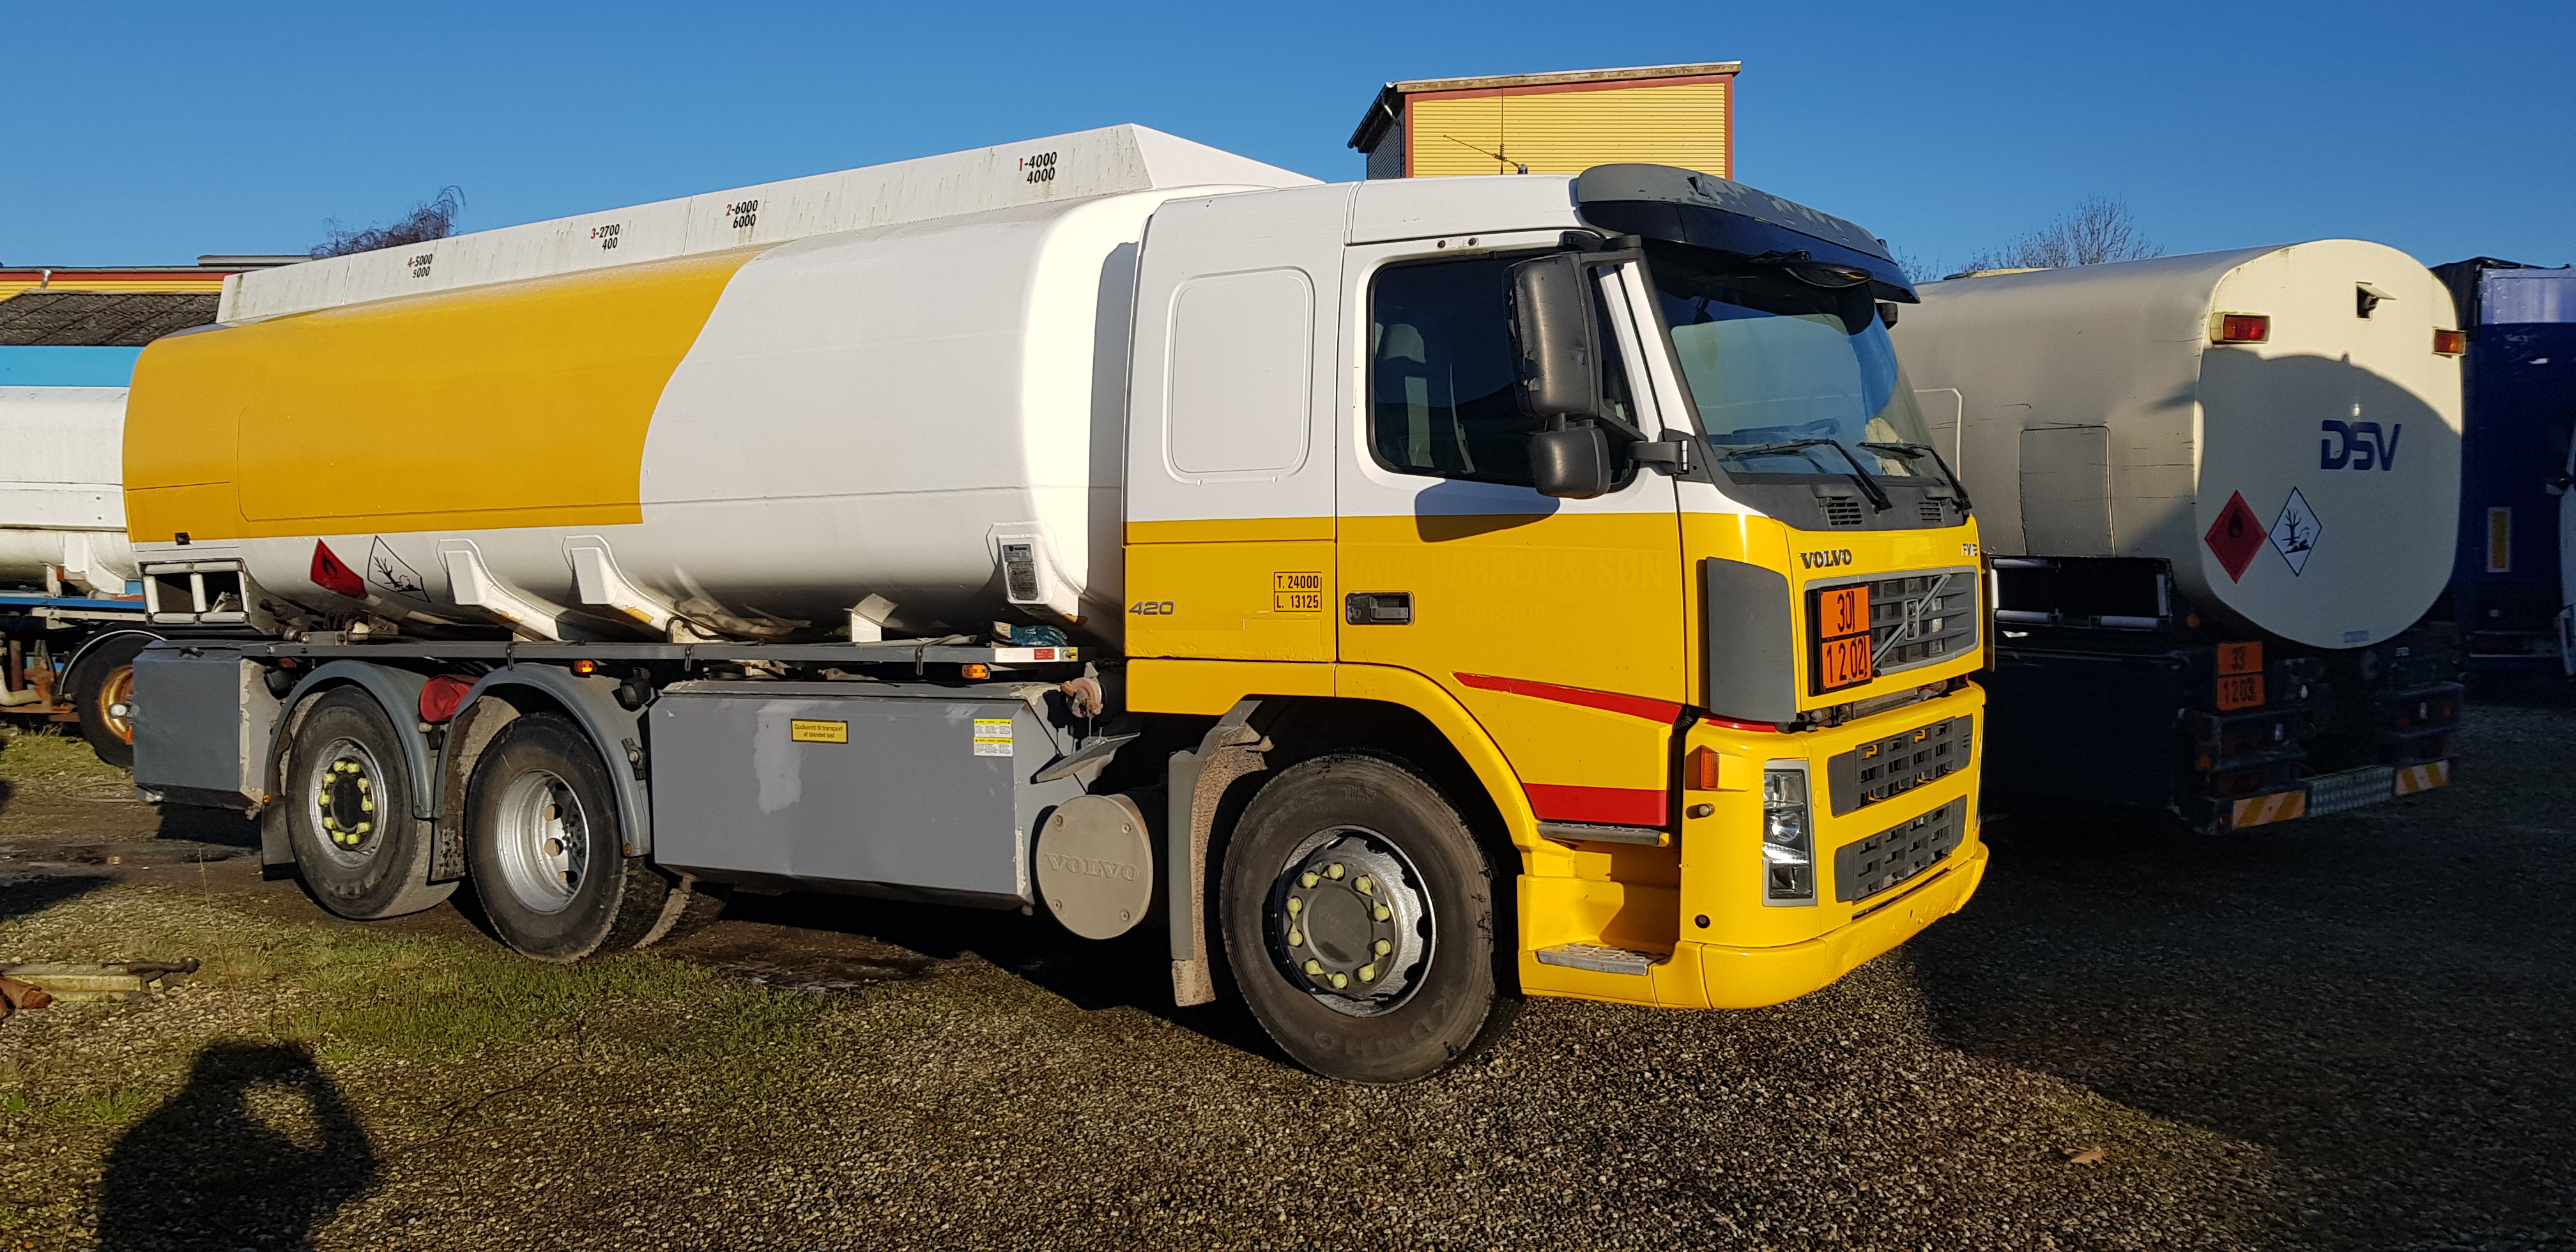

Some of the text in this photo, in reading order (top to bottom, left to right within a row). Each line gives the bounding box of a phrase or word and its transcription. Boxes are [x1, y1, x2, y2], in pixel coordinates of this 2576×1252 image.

[1019, 151, 1057, 171] 1-4000
[1026, 167, 1055, 184] 4000
[726, 199, 758, 217] 2-6000
[733, 213, 756, 229] 6000
[590, 224, 620, 240] 3-2700
[602, 237, 618, 250] 400
[407, 253, 433, 268] 4-5000
[412, 266, 431, 279] 5000
[2321, 420, 2402, 471] DSV
[1798, 549, 1852, 570] VOLVO
[1431, 551, 1547, 589] LARSEN
[1561, 552, 1583, 589] &
[1276, 575, 1319, 589] T. 24000
[1128, 600, 1175, 615] 420
[1276, 595, 1319, 609] L. 13125
[2231, 646, 2246, 670] 33
[2223, 678, 2256, 704] 1203
[1045, 851, 1140, 882] VOLVO
